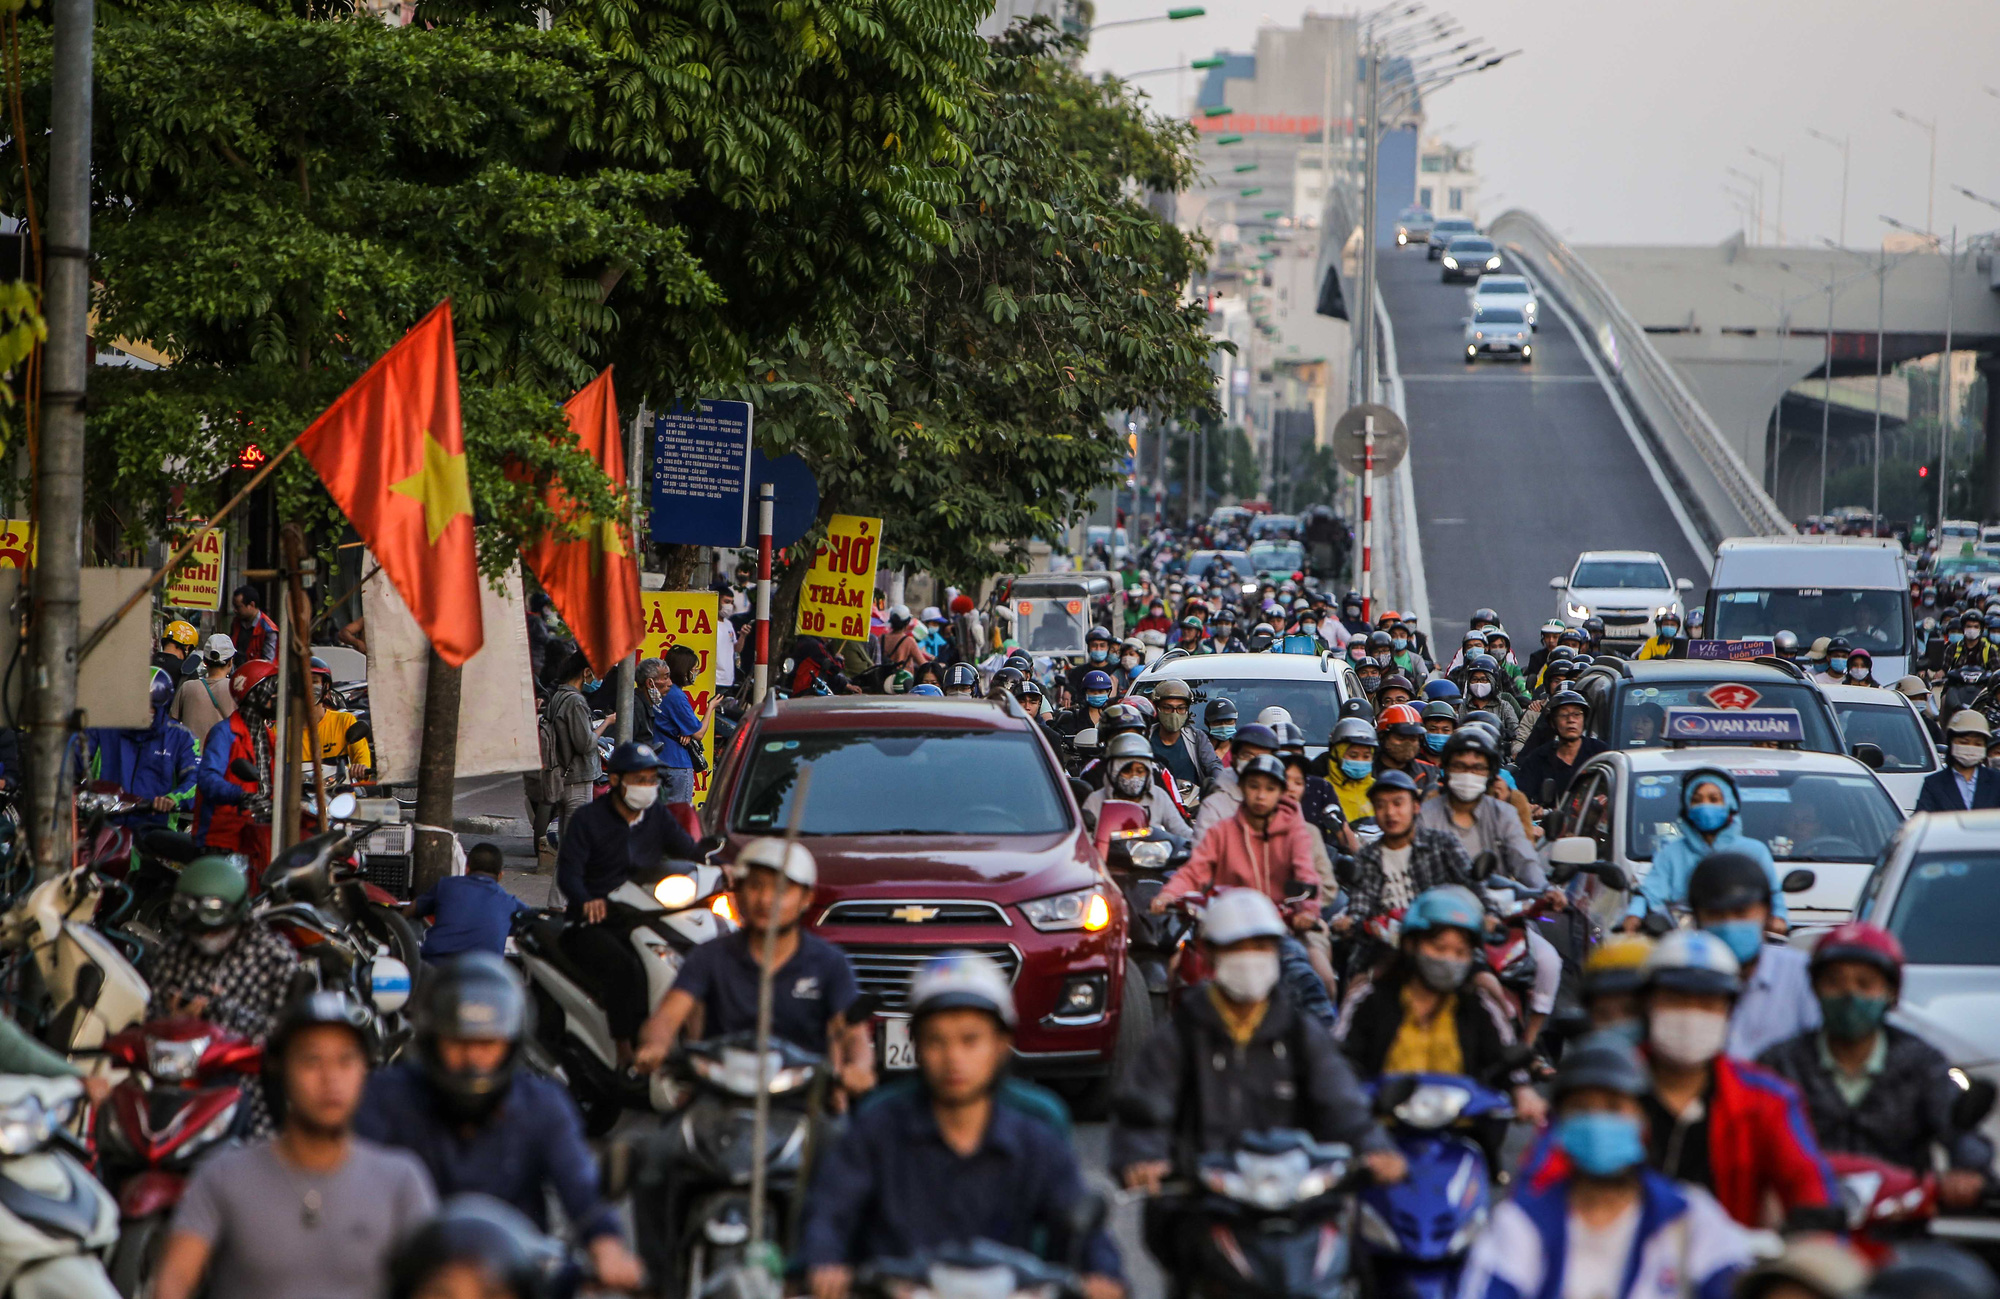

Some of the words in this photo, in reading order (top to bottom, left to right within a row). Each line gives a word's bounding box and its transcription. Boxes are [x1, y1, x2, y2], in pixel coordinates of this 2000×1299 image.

[809, 578, 865, 608] THẮM
[675, 608, 712, 634] TA
[802, 608, 825, 632] BÒ
[841, 614, 864, 637] GÀ
[1729, 650, 1750, 660] Luôn
[1743, 641, 1764, 649] Luôn
[1710, 719, 1744, 734] VẠN
[1745, 717, 1790, 732] XUÂN
